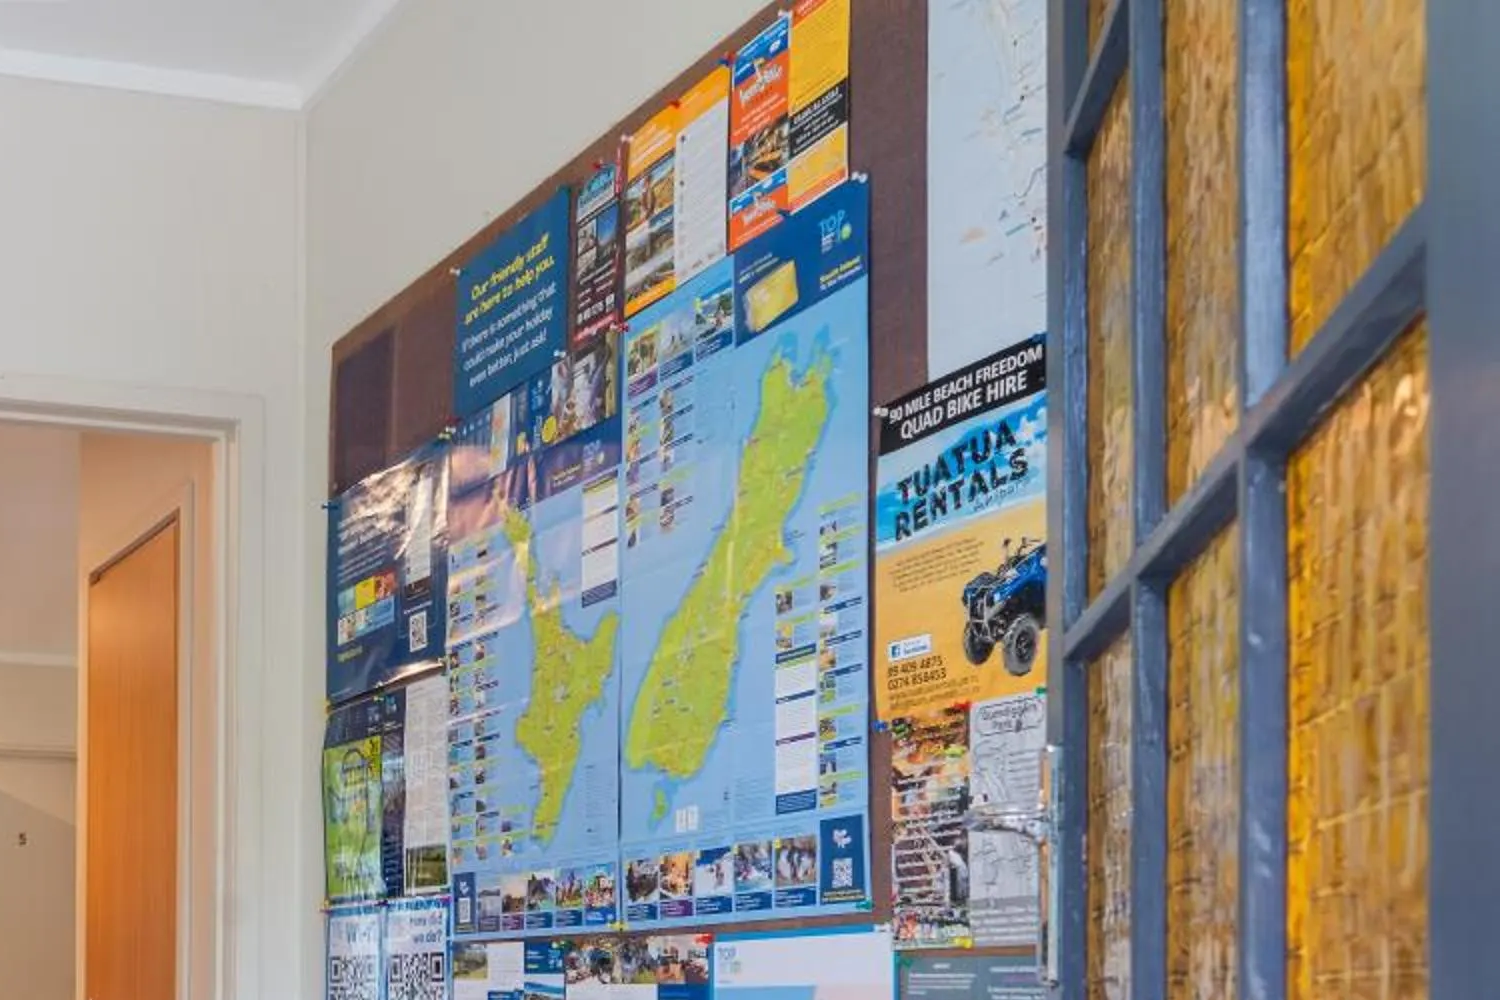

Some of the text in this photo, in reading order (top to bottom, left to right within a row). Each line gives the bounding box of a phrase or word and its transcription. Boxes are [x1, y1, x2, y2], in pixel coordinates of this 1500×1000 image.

[889, 343, 1044, 425] 90 MILE BEACH FREEDOM
[900, 369, 1029, 441] QUAD BIKE HIRE
[895, 447, 1029, 542] RENTALS
[897, 420, 1017, 505] TUATUA
